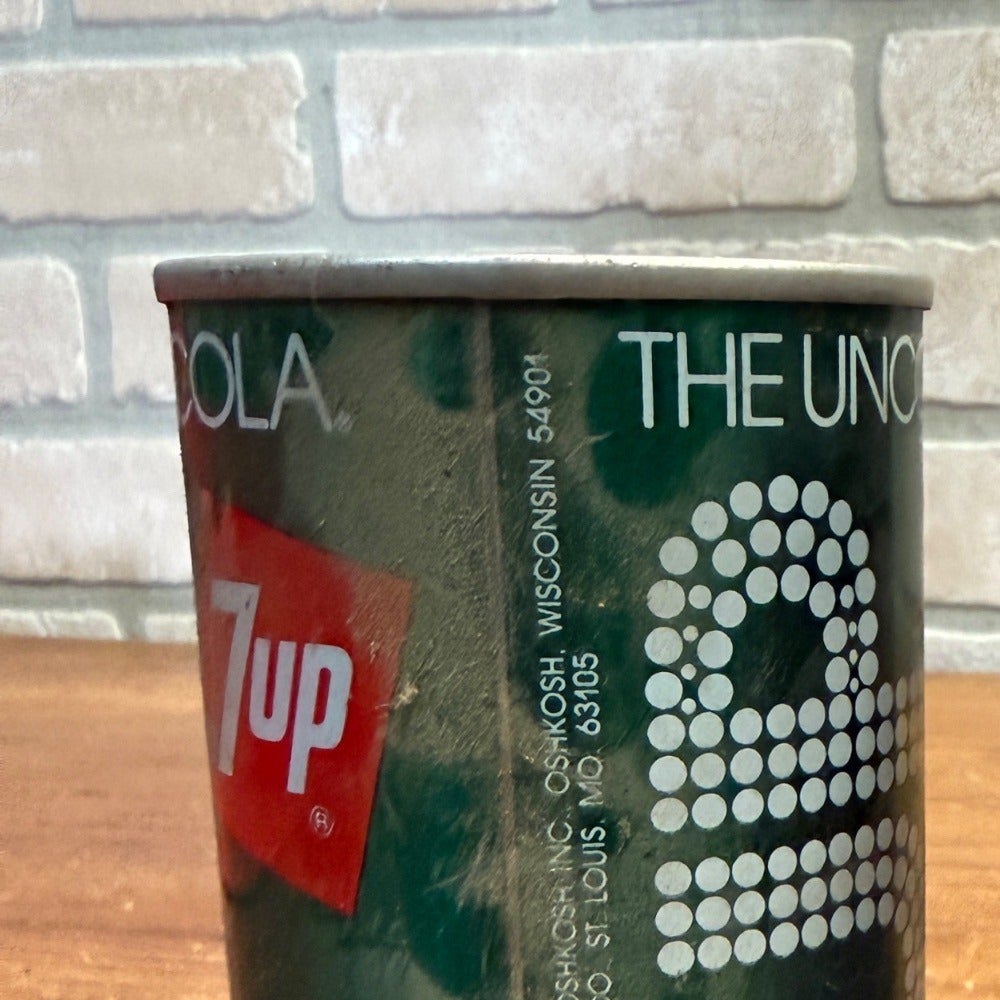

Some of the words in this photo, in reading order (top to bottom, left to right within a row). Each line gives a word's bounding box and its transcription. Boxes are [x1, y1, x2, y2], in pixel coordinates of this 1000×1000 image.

[523, 354, 554, 444] 54901
[617, 330, 785, 430] THE
[529, 458, 564, 637] WISCONSIN
[571, 652, 601, 736] 63105
